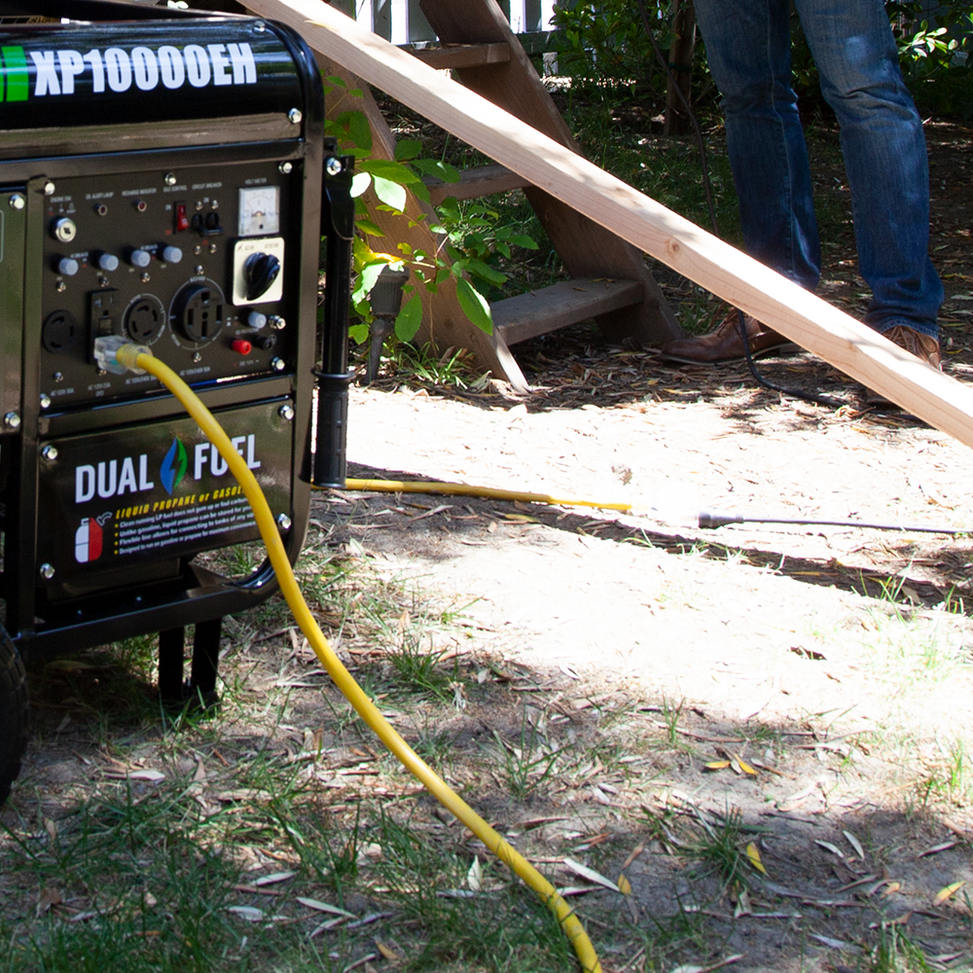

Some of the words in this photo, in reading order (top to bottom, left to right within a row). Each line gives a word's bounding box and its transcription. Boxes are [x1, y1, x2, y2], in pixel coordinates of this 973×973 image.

[29, 42, 257, 96] XP10000EH
[75, 454, 155, 504] DUAL
[116, 504, 149, 520] LIQUID
[153, 495, 196, 512] PROPANE
[199, 493, 210, 503] or
[213, 486, 245, 500] GASOL
